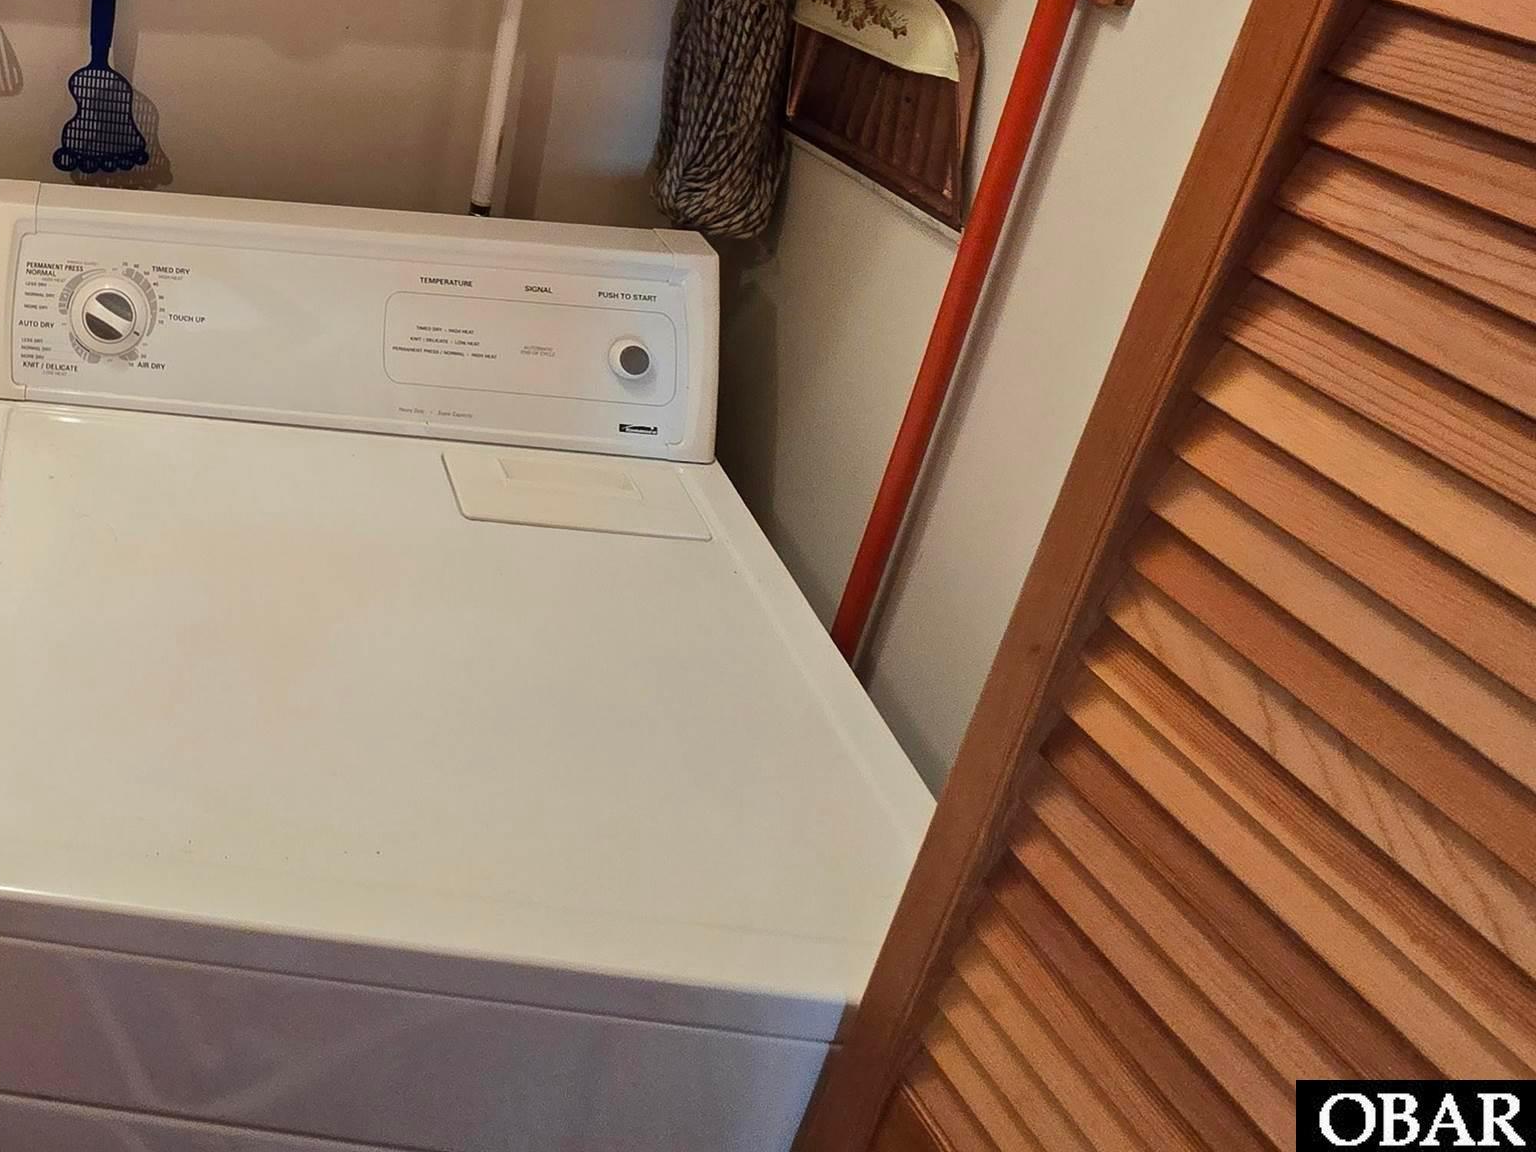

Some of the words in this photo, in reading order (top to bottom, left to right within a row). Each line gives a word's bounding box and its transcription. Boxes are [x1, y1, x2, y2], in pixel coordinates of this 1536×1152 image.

[26, 261, 64, 270] PERMANENT
[64, 264, 84, 272] PRESS
[152, 266, 174, 274] TIMED
[175, 266, 191, 275] DRY
[26, 269, 56, 278] NORMAL
[420, 276, 473, 288] TEMPERATURE
[524, 284, 552, 294] SIGNAL
[598, 290, 620, 300] PUSH
[620, 292, 632, 300] TO
[632, 294, 657, 302] START
[168, 314, 194, 322] TOUCH
[195, 315, 206, 323] UP
[40, 321, 55, 329] DRY
[22, 360, 40, 368] KNIT
[46, 362, 78, 372] DELICATE
[150, 362, 166, 370] DRY
